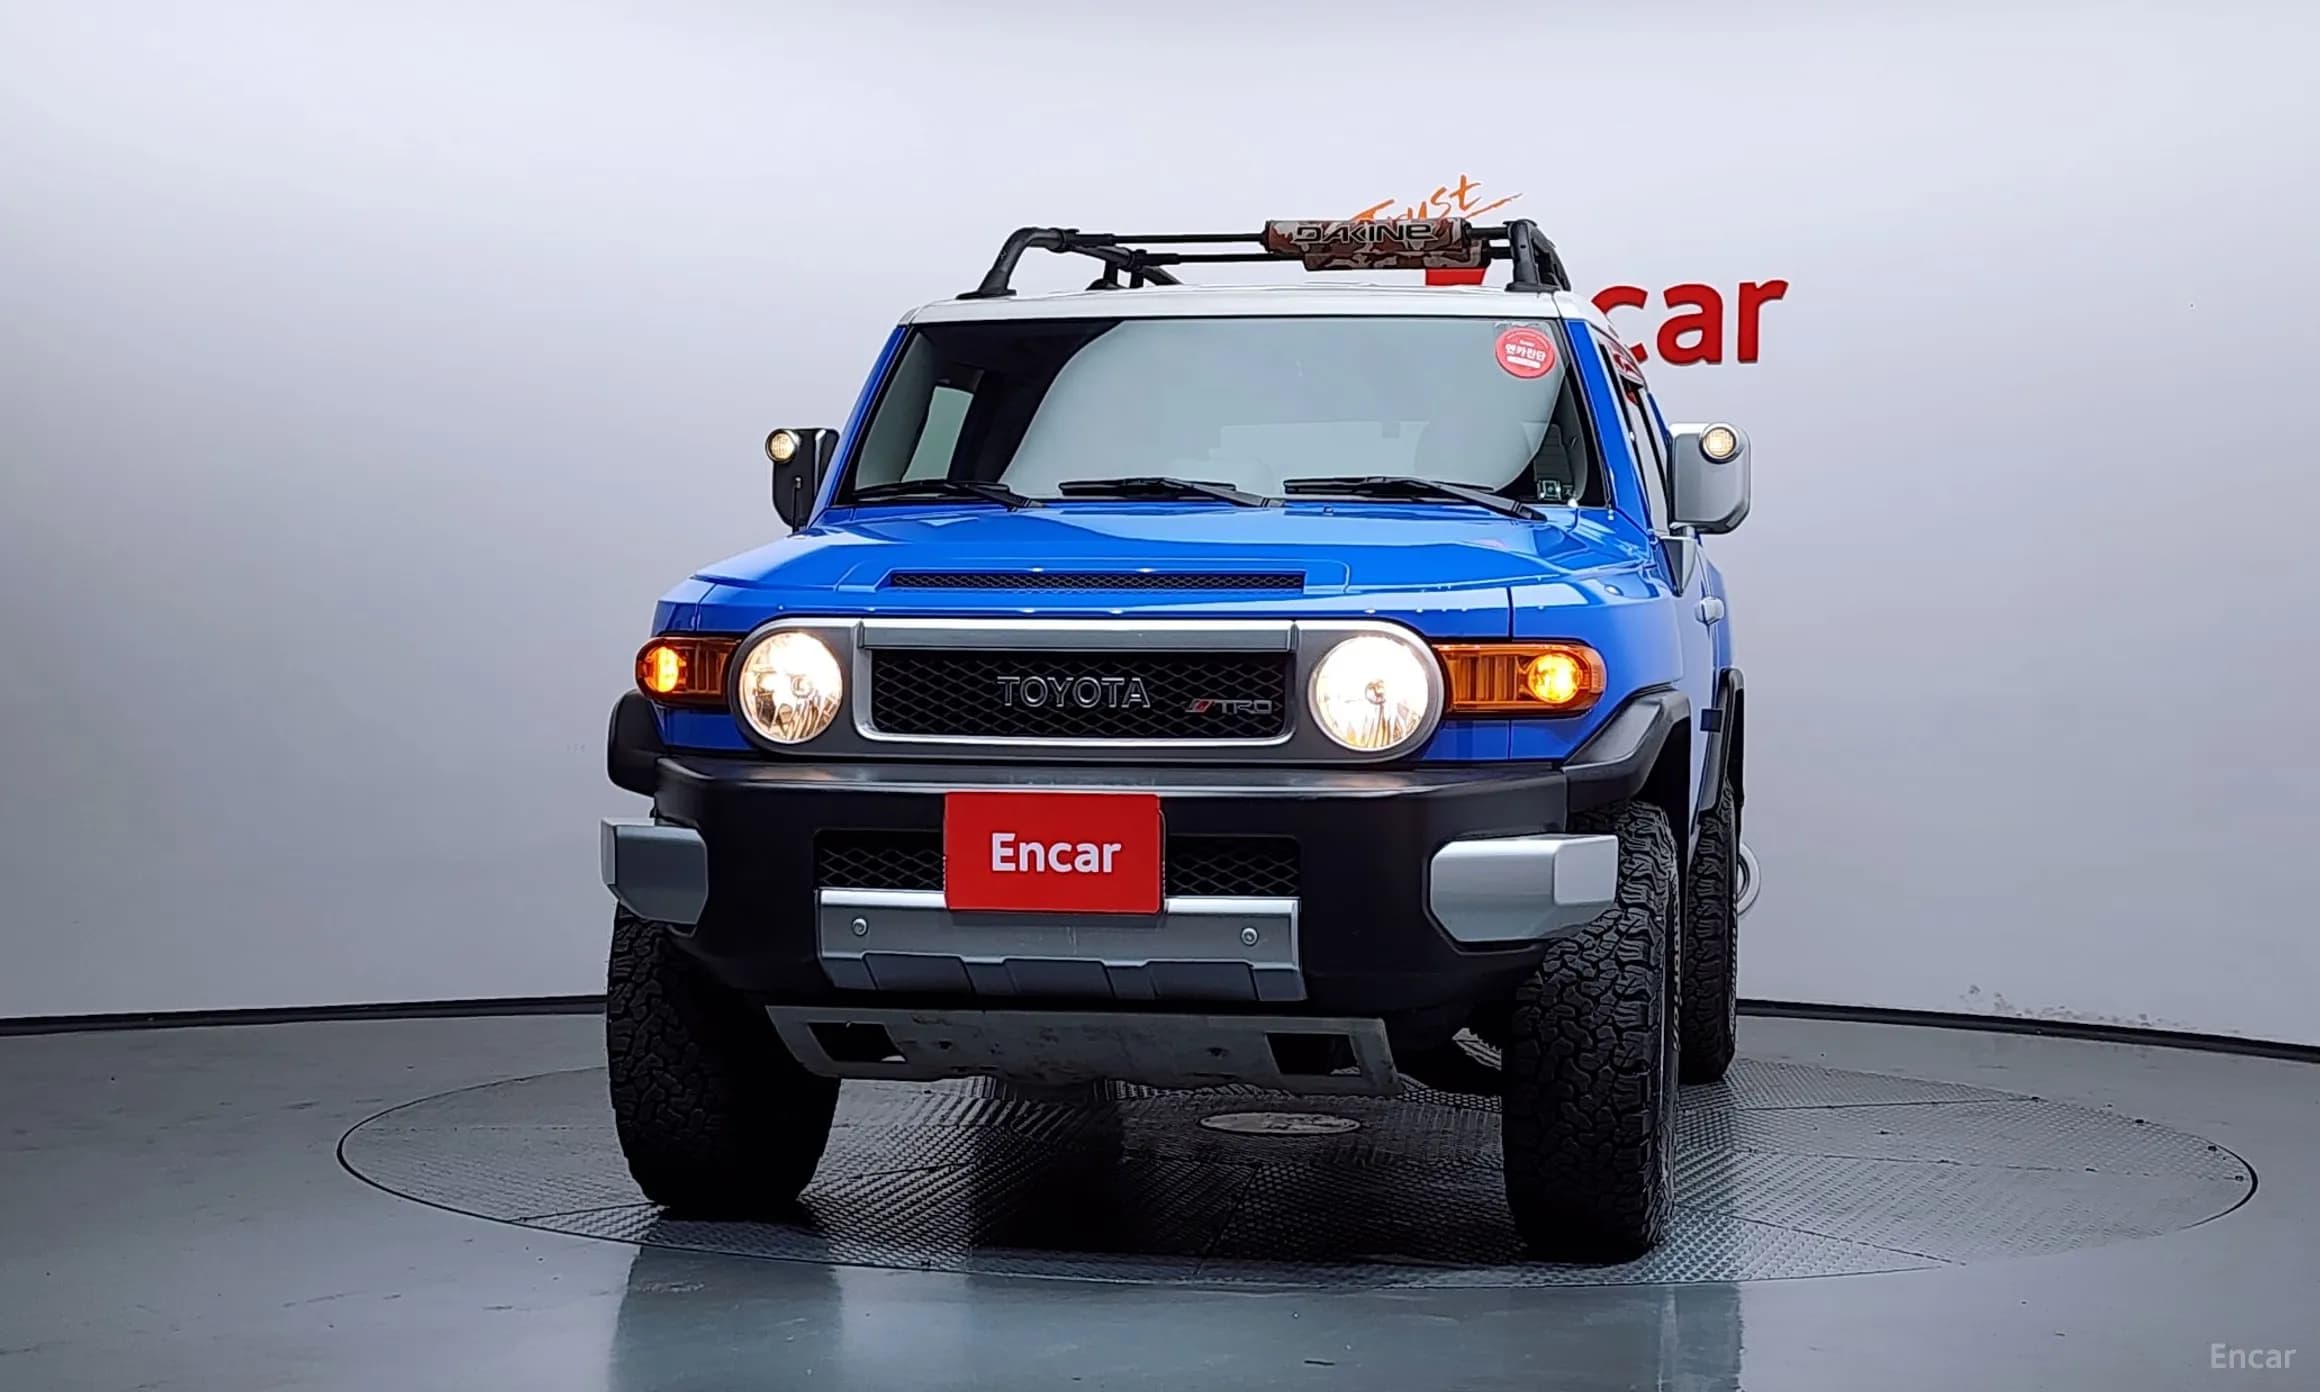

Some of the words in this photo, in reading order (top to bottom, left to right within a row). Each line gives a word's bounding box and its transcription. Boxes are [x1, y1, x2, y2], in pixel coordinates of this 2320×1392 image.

[997, 676, 1151, 708] TOYOTA
[1214, 699, 1273, 715] TRD
[992, 832, 1122, 873] Encar
